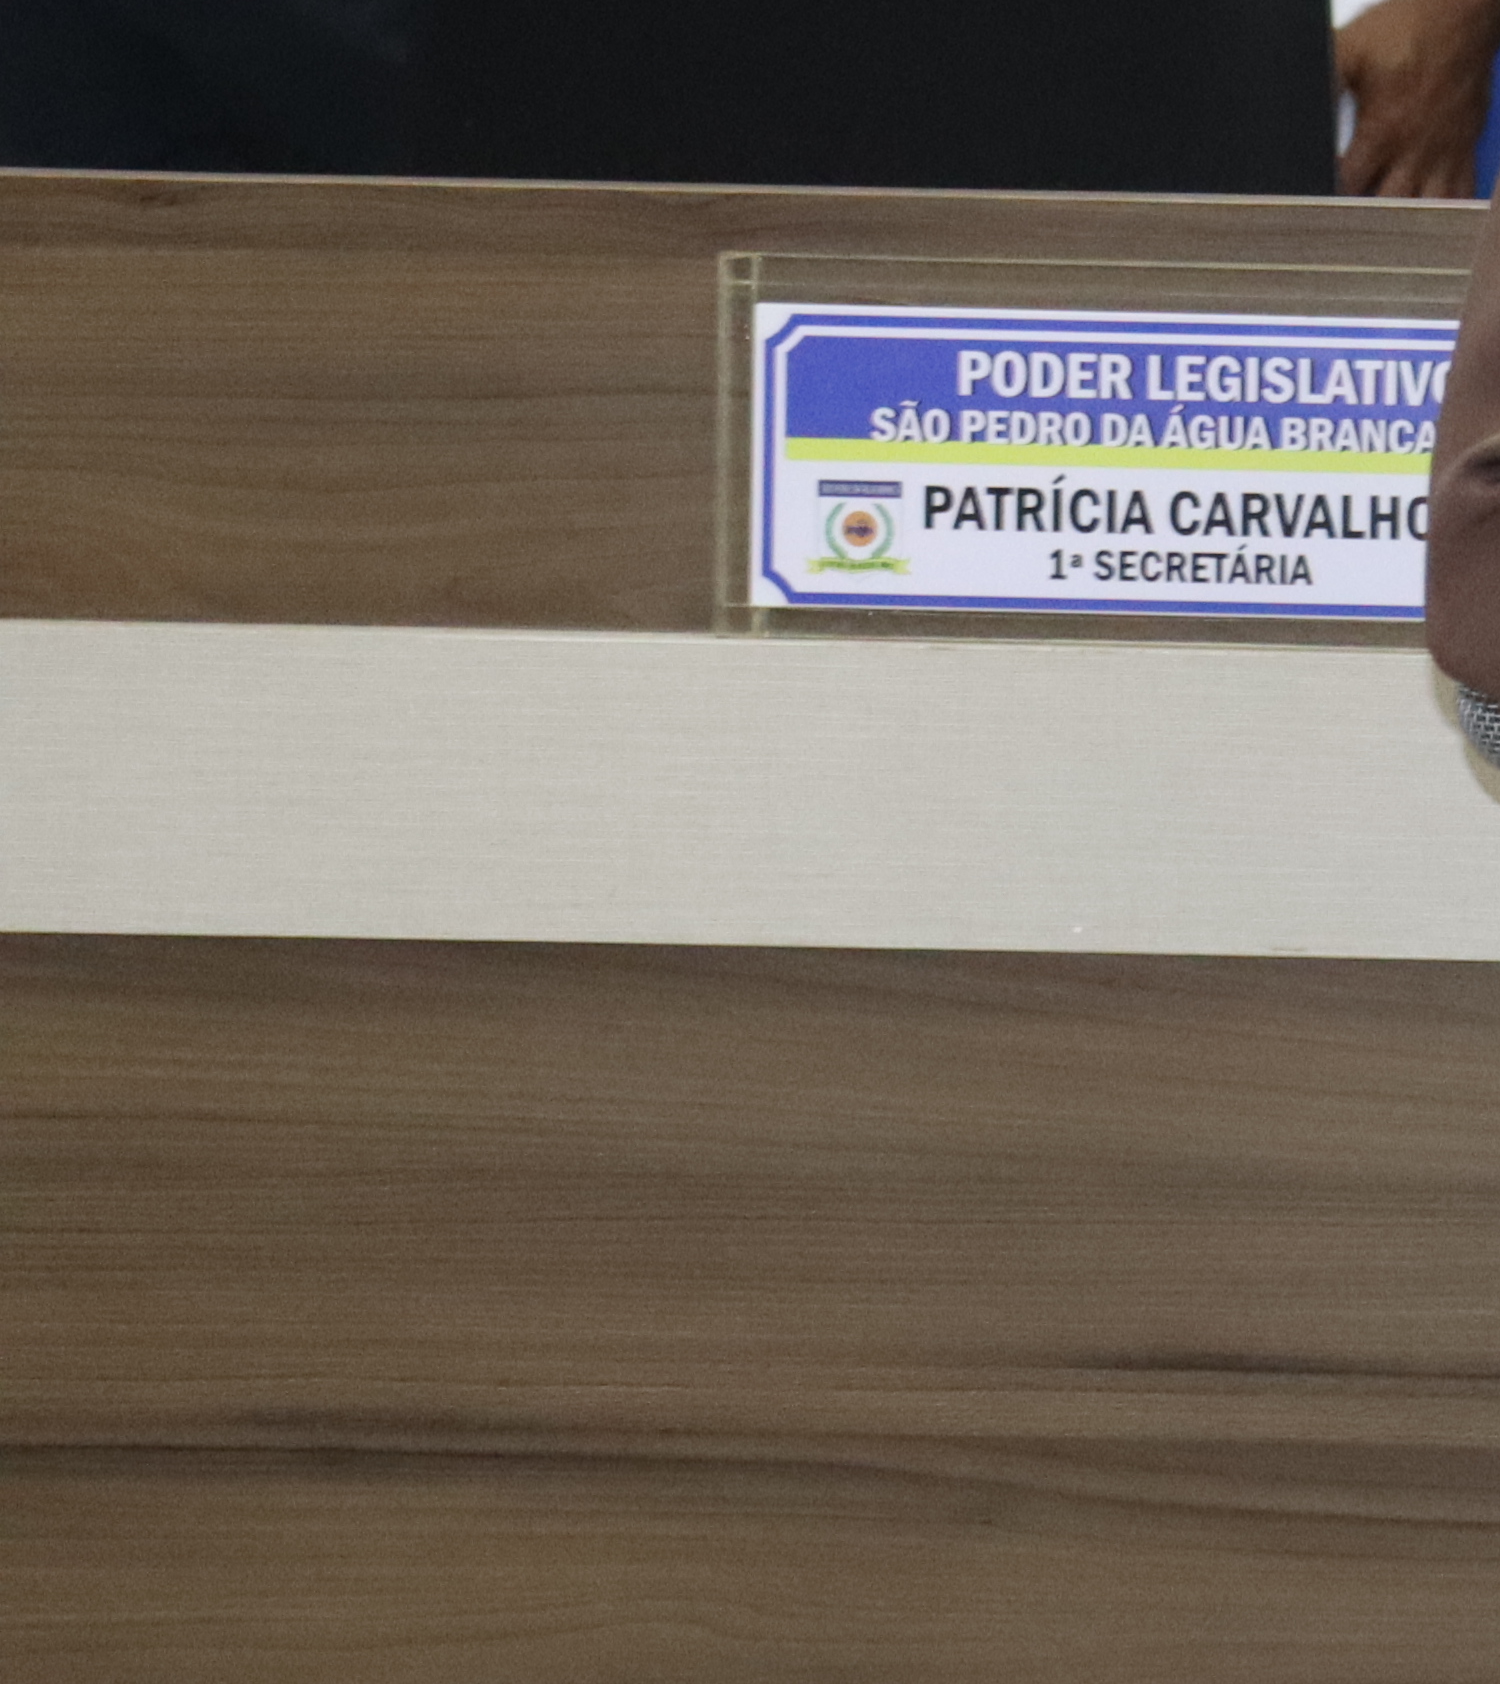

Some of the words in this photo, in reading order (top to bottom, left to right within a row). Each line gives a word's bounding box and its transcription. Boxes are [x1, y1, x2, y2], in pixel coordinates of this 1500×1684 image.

[958, 350, 1133, 401] PODER
[871, 400, 952, 443] SÃO
[961, 409, 1092, 448] PEDRO
[1102, 412, 1154, 450] DA
[1164, 404, 1270, 453] ÁGUA
[923, 476, 1153, 535] PATRÍCIA
[1048, 549, 1083, 580] 1ª
[1093, 544, 1314, 586] SECRETÁRIA
